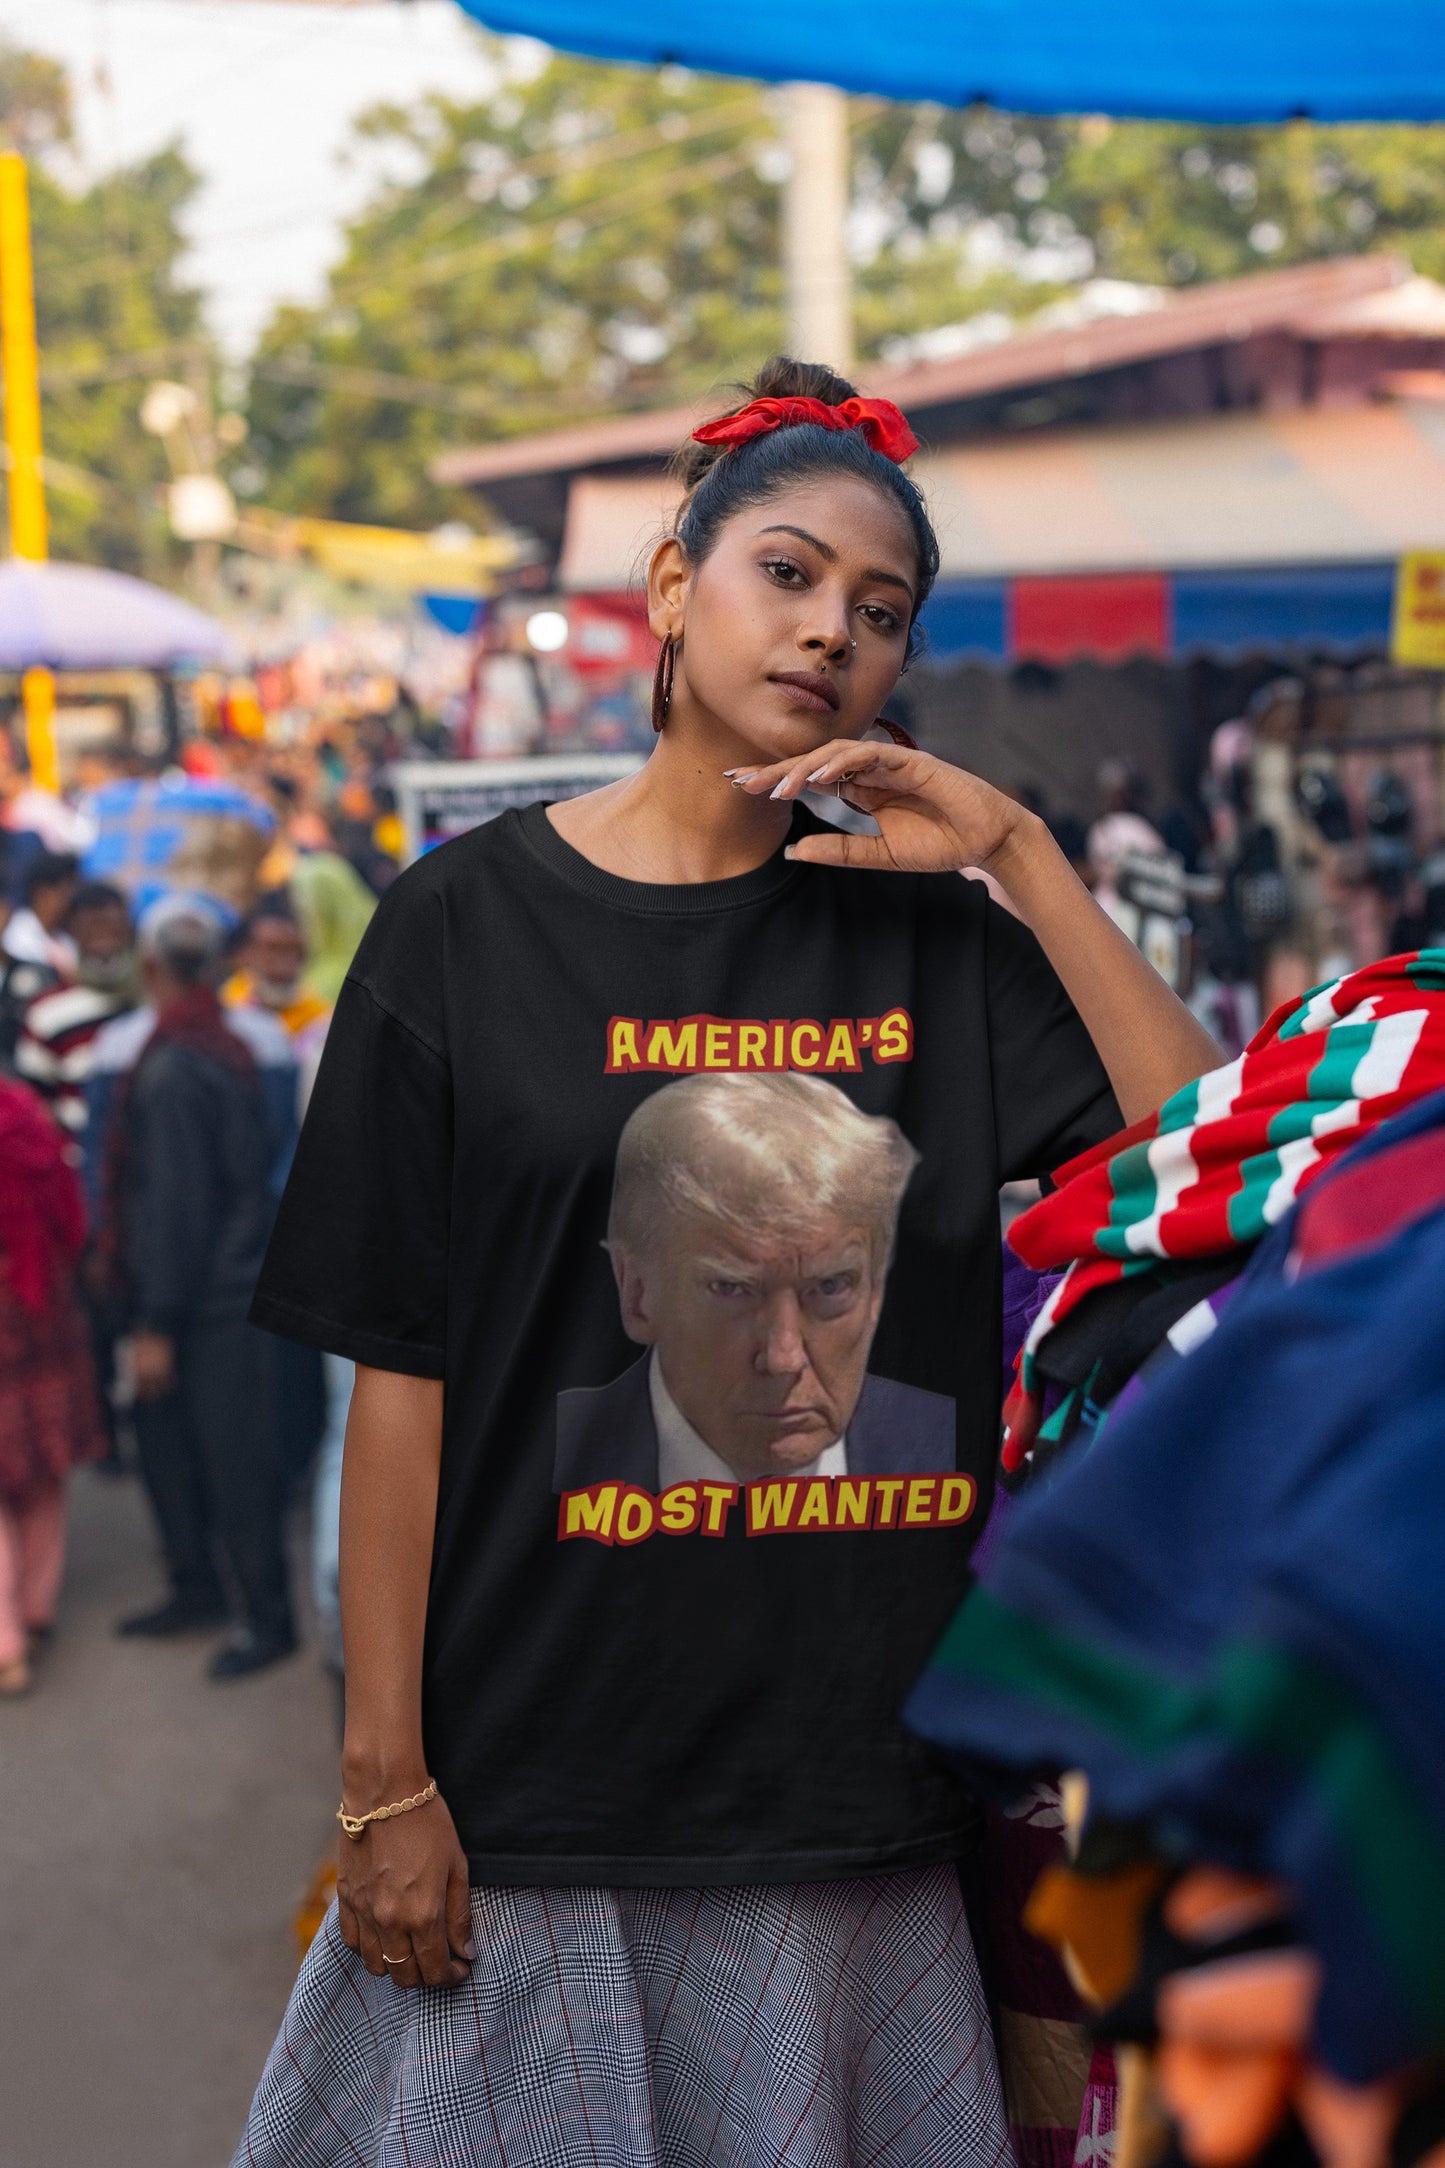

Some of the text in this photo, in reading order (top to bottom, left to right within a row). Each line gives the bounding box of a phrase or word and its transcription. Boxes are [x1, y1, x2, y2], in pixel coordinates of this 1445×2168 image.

[607, 1010, 912, 1072] AMERICA'S
[560, 1474, 975, 1544] MOST WANTED
